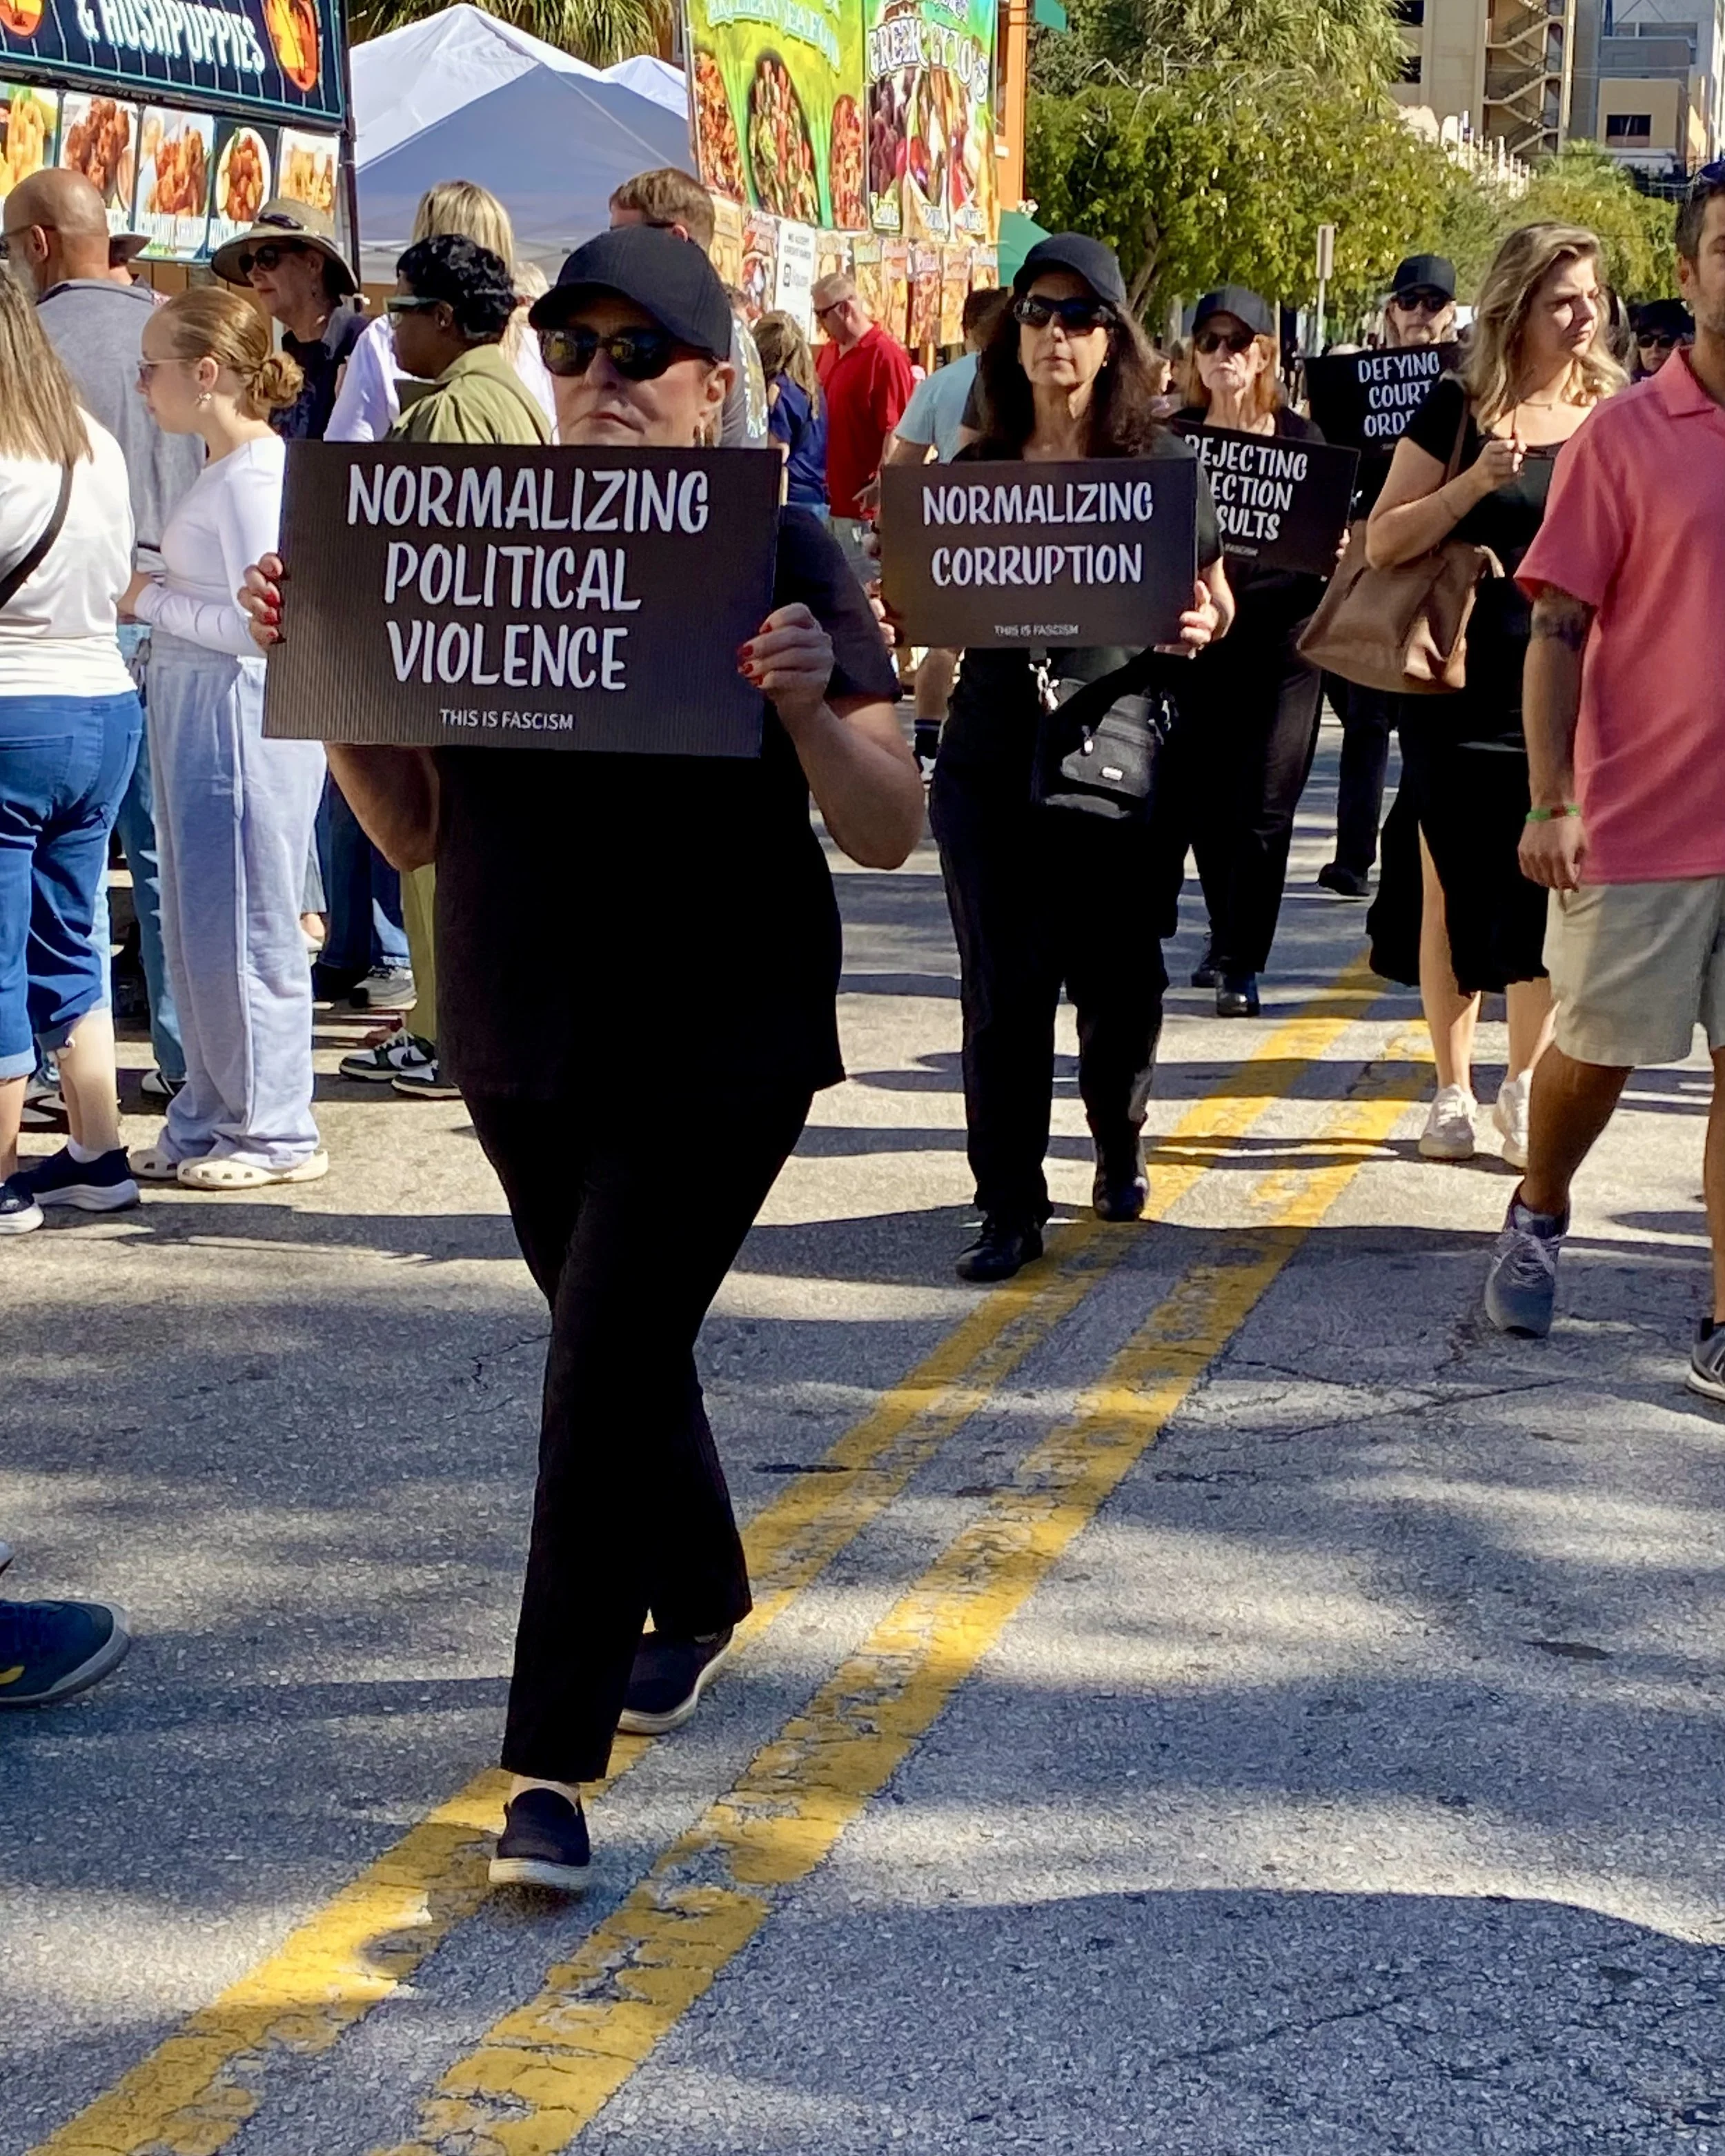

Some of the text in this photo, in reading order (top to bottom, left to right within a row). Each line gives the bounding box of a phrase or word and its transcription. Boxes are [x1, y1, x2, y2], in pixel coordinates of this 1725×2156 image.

[75, 0, 266, 74] & HUSHPUPPIES
[1358, 350, 1440, 384] DEFYING
[1369, 379, 1432, 409] COURT
[348, 464, 709, 534] NORMALIZING
[923, 482, 1154, 526] NORMALIZING
[1210, 471, 1293, 511] ECTION
[1216, 504, 1281, 541] SULTS
[384, 542, 642, 611] POLITICAL
[931, 543, 1143, 586] CORRUPTION
[994, 624, 1079, 637] THIS IS FASCISM
[386, 620, 629, 691] VIOLENCE
[440, 709, 574, 731] THIS IS FASCISM
